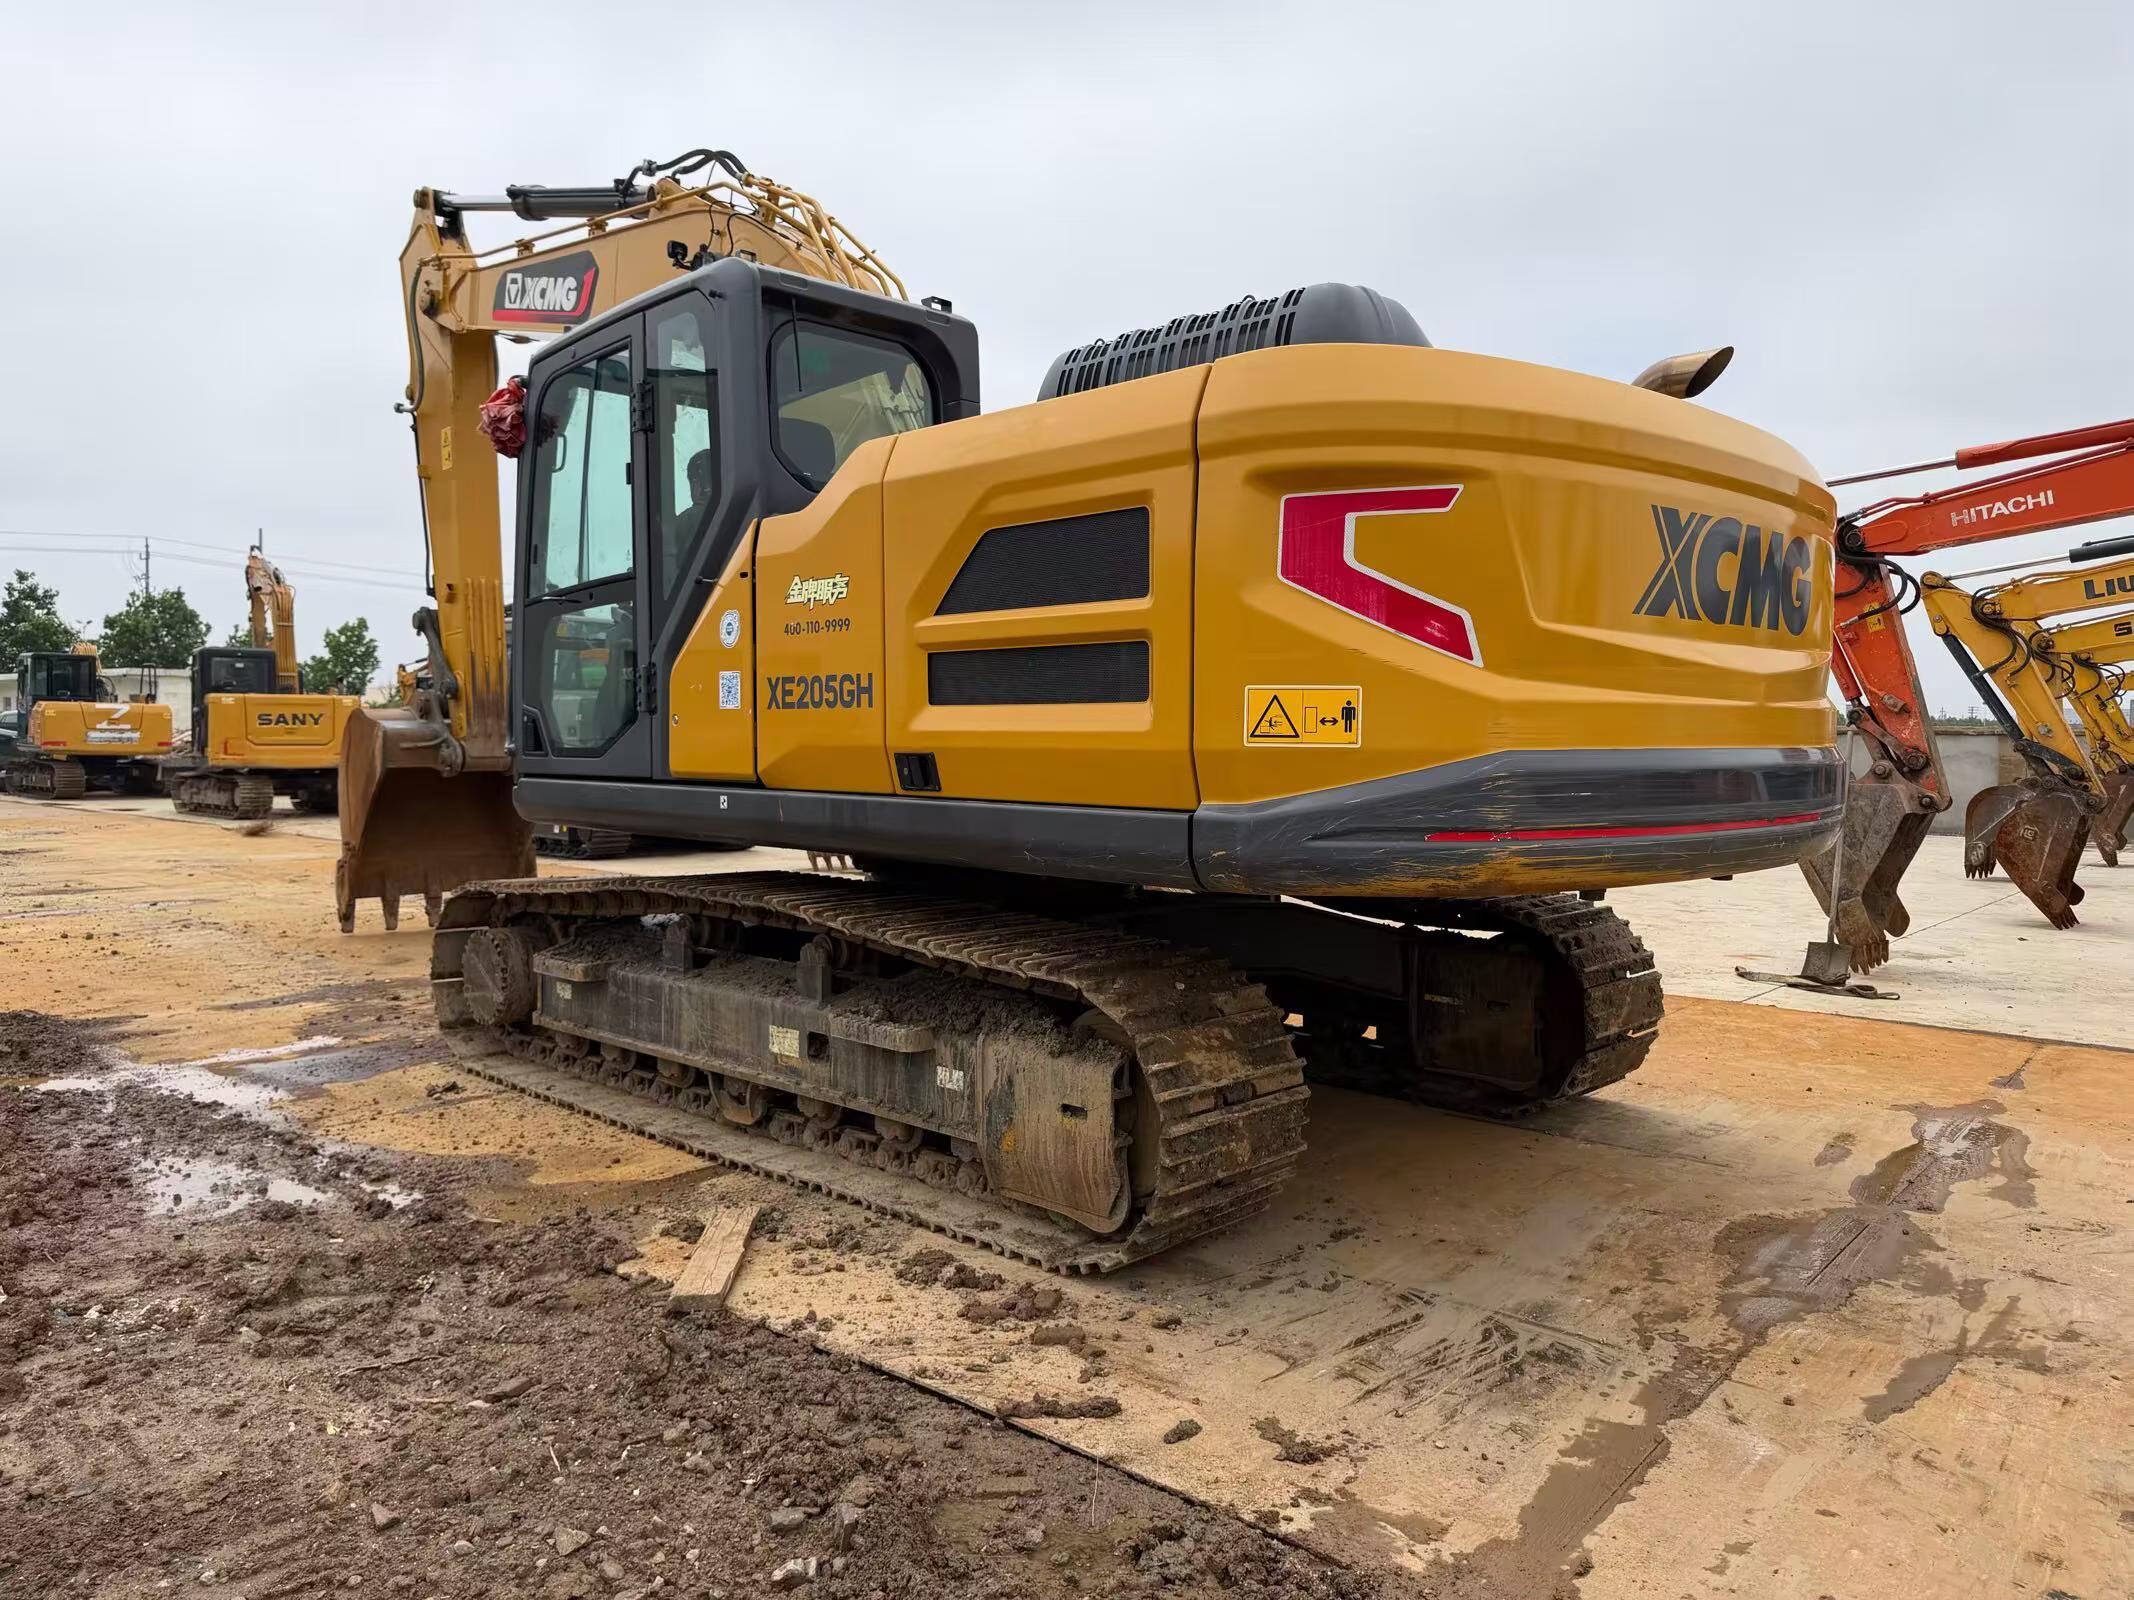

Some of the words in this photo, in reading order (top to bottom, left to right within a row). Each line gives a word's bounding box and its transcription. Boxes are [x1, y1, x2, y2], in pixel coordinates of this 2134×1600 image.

[522, 275, 577, 311] XCMG
[1951, 489, 2054, 527] HITACHI
[1632, 504, 1811, 636] XCMG
[785, 573, 849, 611] 金牌服务
[784, 617, 850, 635] 400-110-9999
[767, 673, 873, 710] XE205GH
[257, 713, 324, 726] SANY
